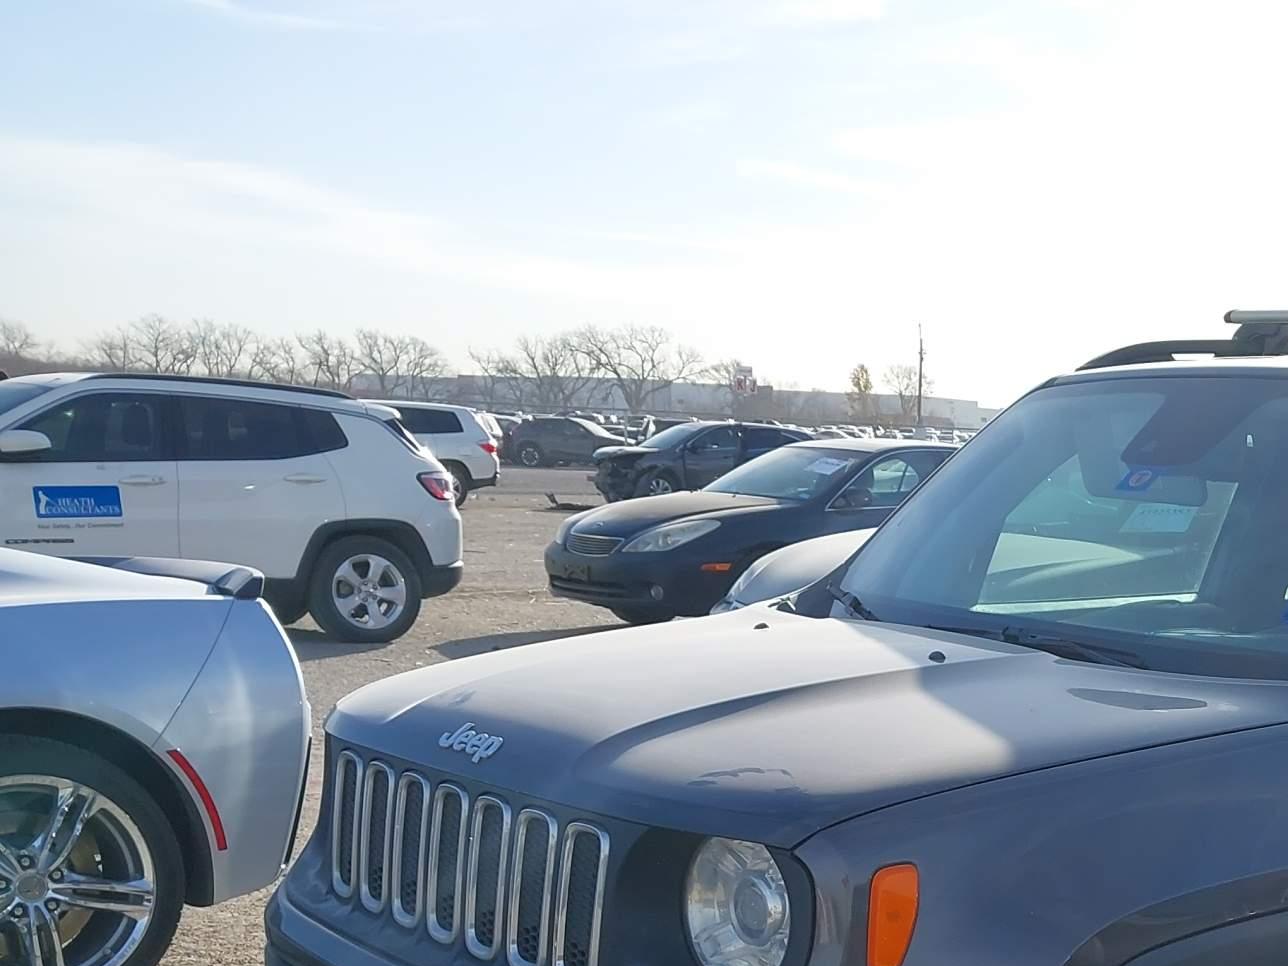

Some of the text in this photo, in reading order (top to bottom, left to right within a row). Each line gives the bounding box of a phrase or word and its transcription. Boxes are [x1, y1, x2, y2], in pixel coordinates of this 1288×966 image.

[57, 497, 95, 506] HEATH
[46, 504, 121, 514] CONSULTANTS
[438, 722, 504, 764] Jeep
